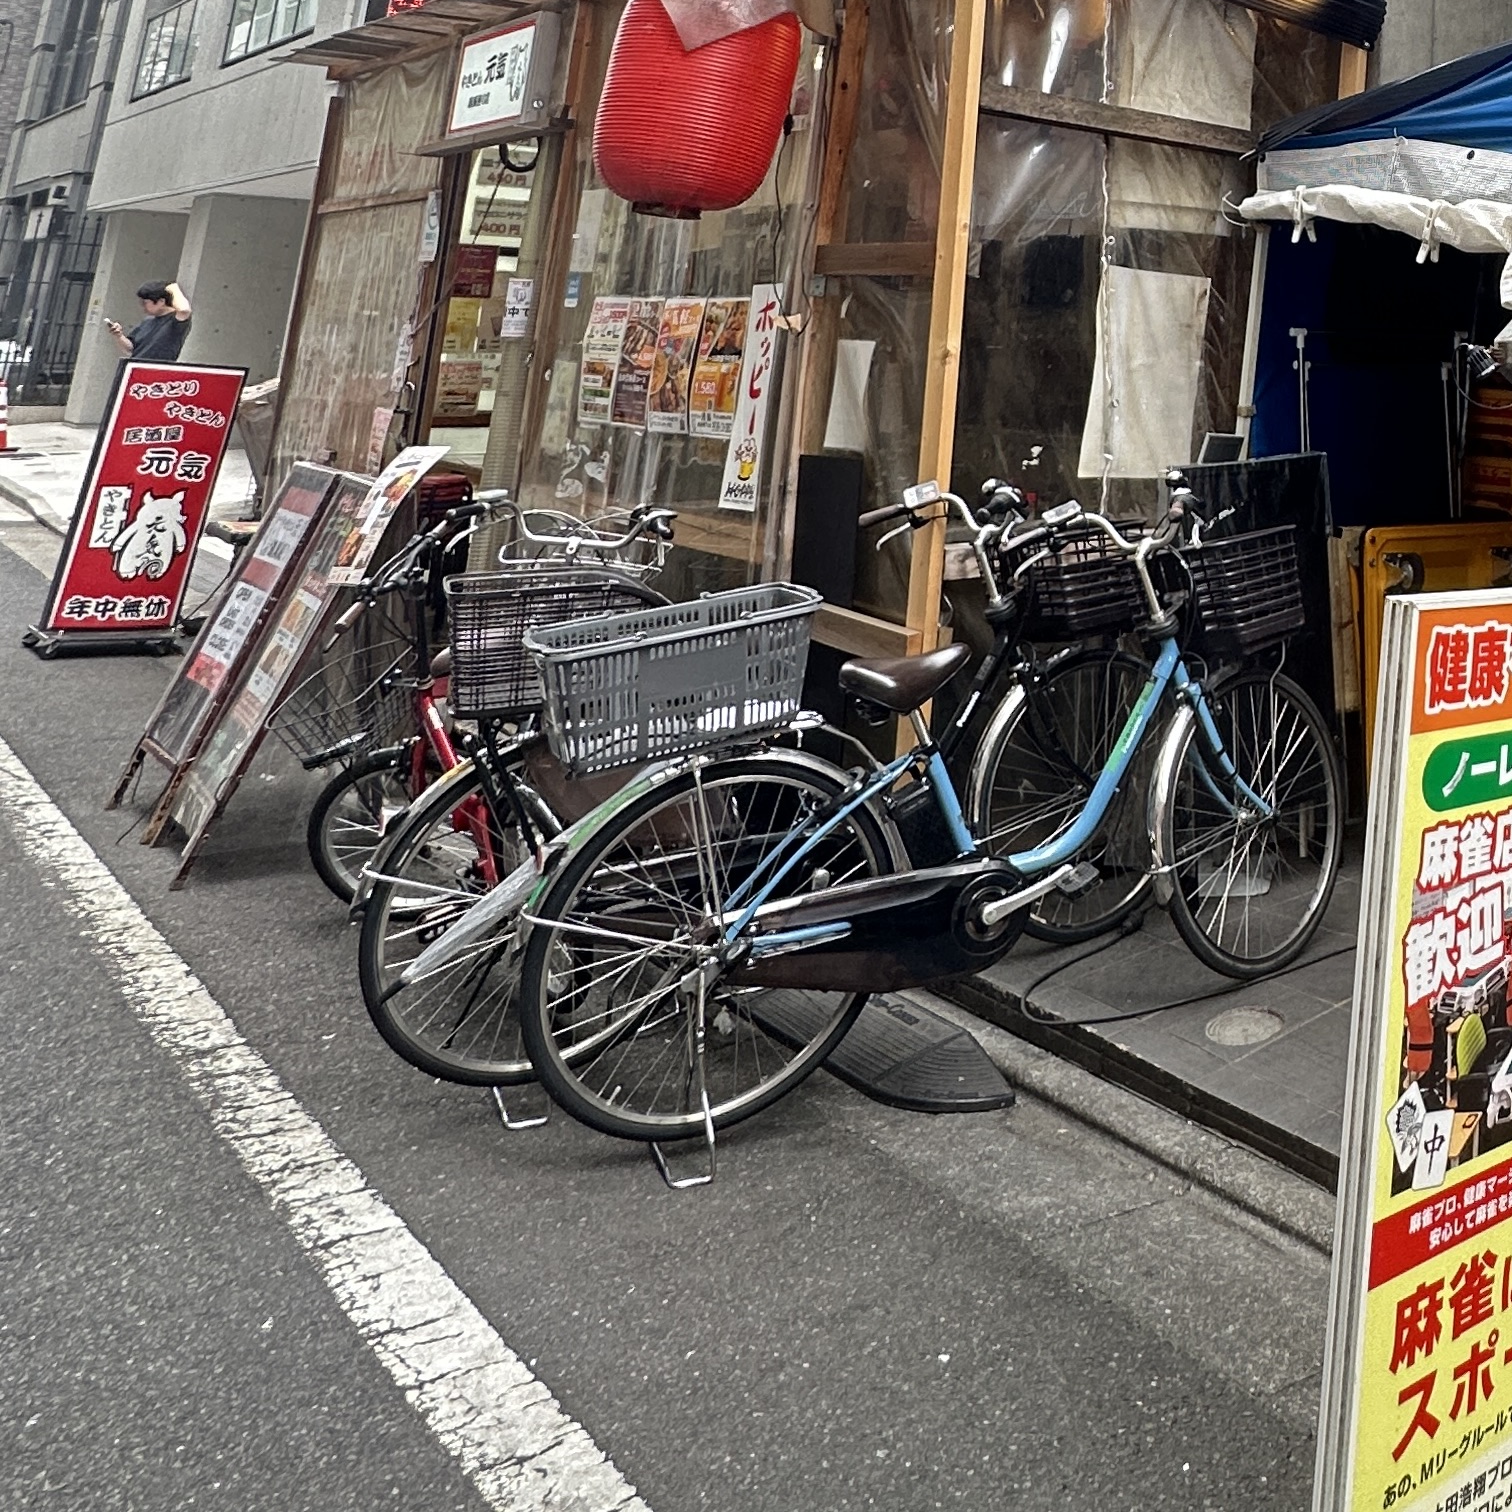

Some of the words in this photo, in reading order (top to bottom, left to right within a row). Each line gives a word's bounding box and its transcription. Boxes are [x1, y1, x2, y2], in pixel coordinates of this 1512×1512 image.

[130, 380, 200, 400] やきとり
[163, 402, 226, 428] やきとん
[122, 425, 184, 446] 居酒屋
[137, 447, 211, 483] 元気
[94, 488, 123, 546] やきとん
[63, 594, 172, 621] 年中無休
